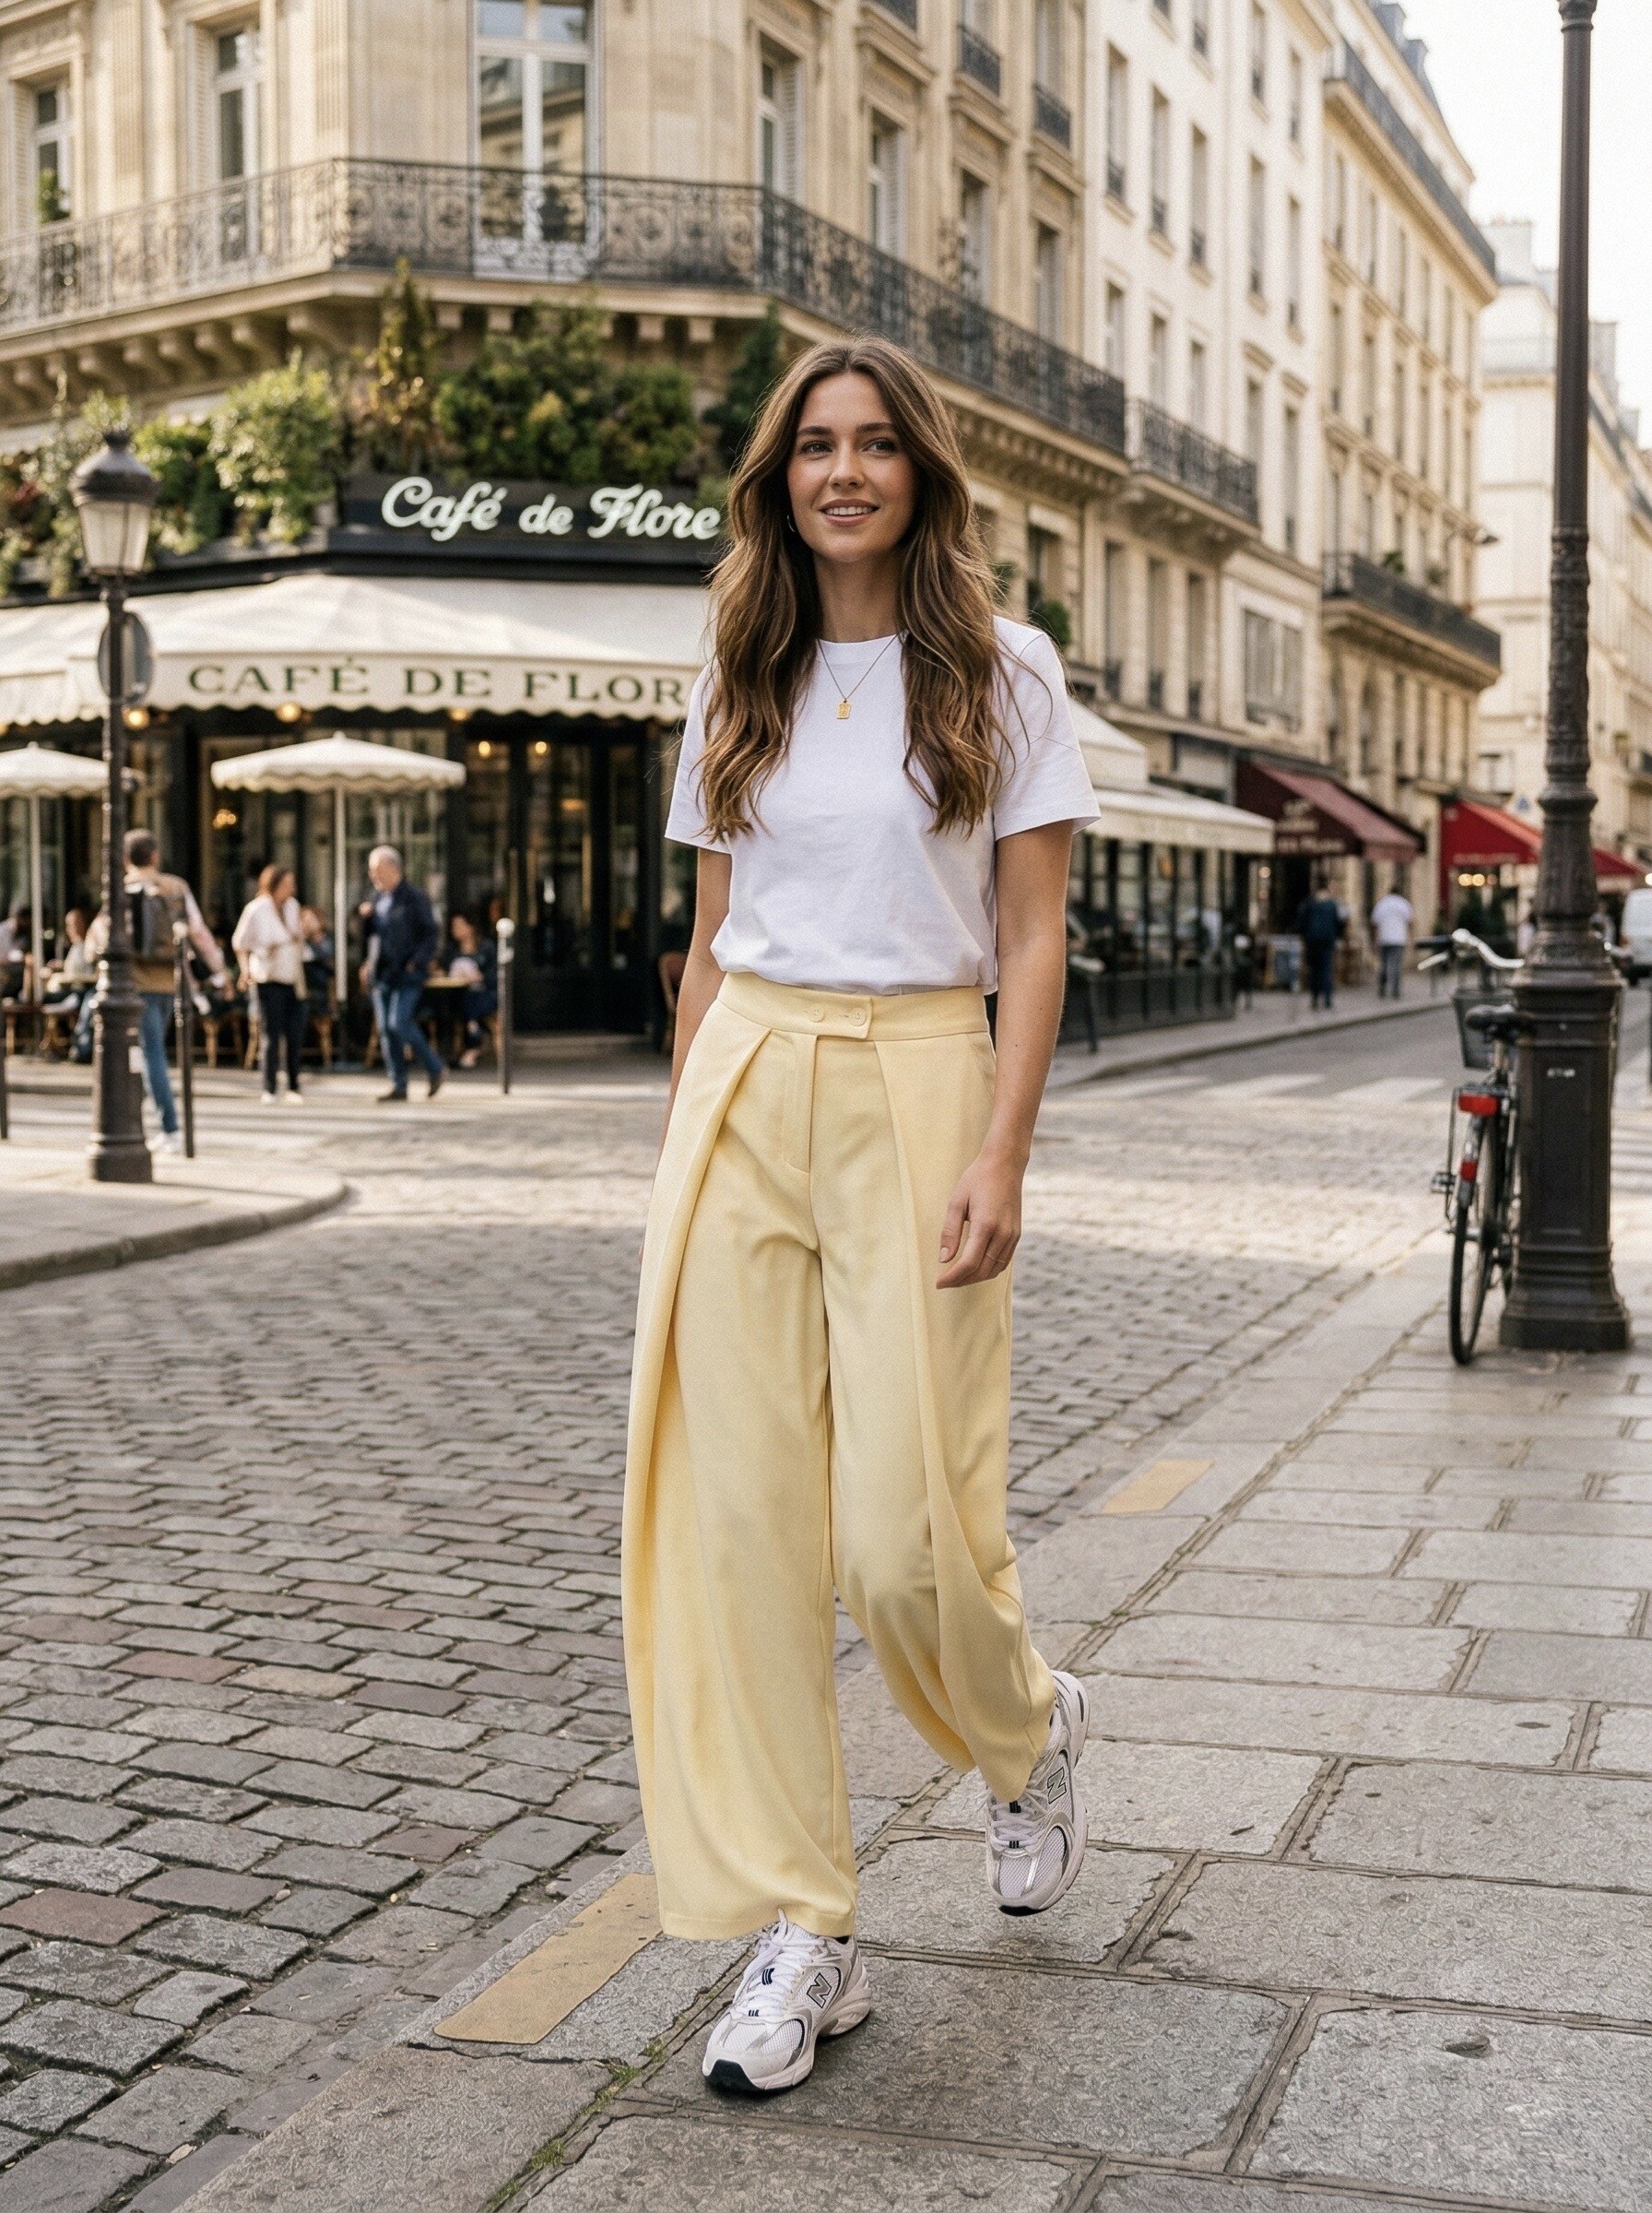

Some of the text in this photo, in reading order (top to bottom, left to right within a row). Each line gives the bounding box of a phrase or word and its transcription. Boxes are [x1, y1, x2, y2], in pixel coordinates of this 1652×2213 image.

[381, 476, 722, 541] Café de Flore
[188, 657, 369, 695] CAFÉ
[404, 668, 492, 698] DE
[807, 1972, 832, 2008] N
